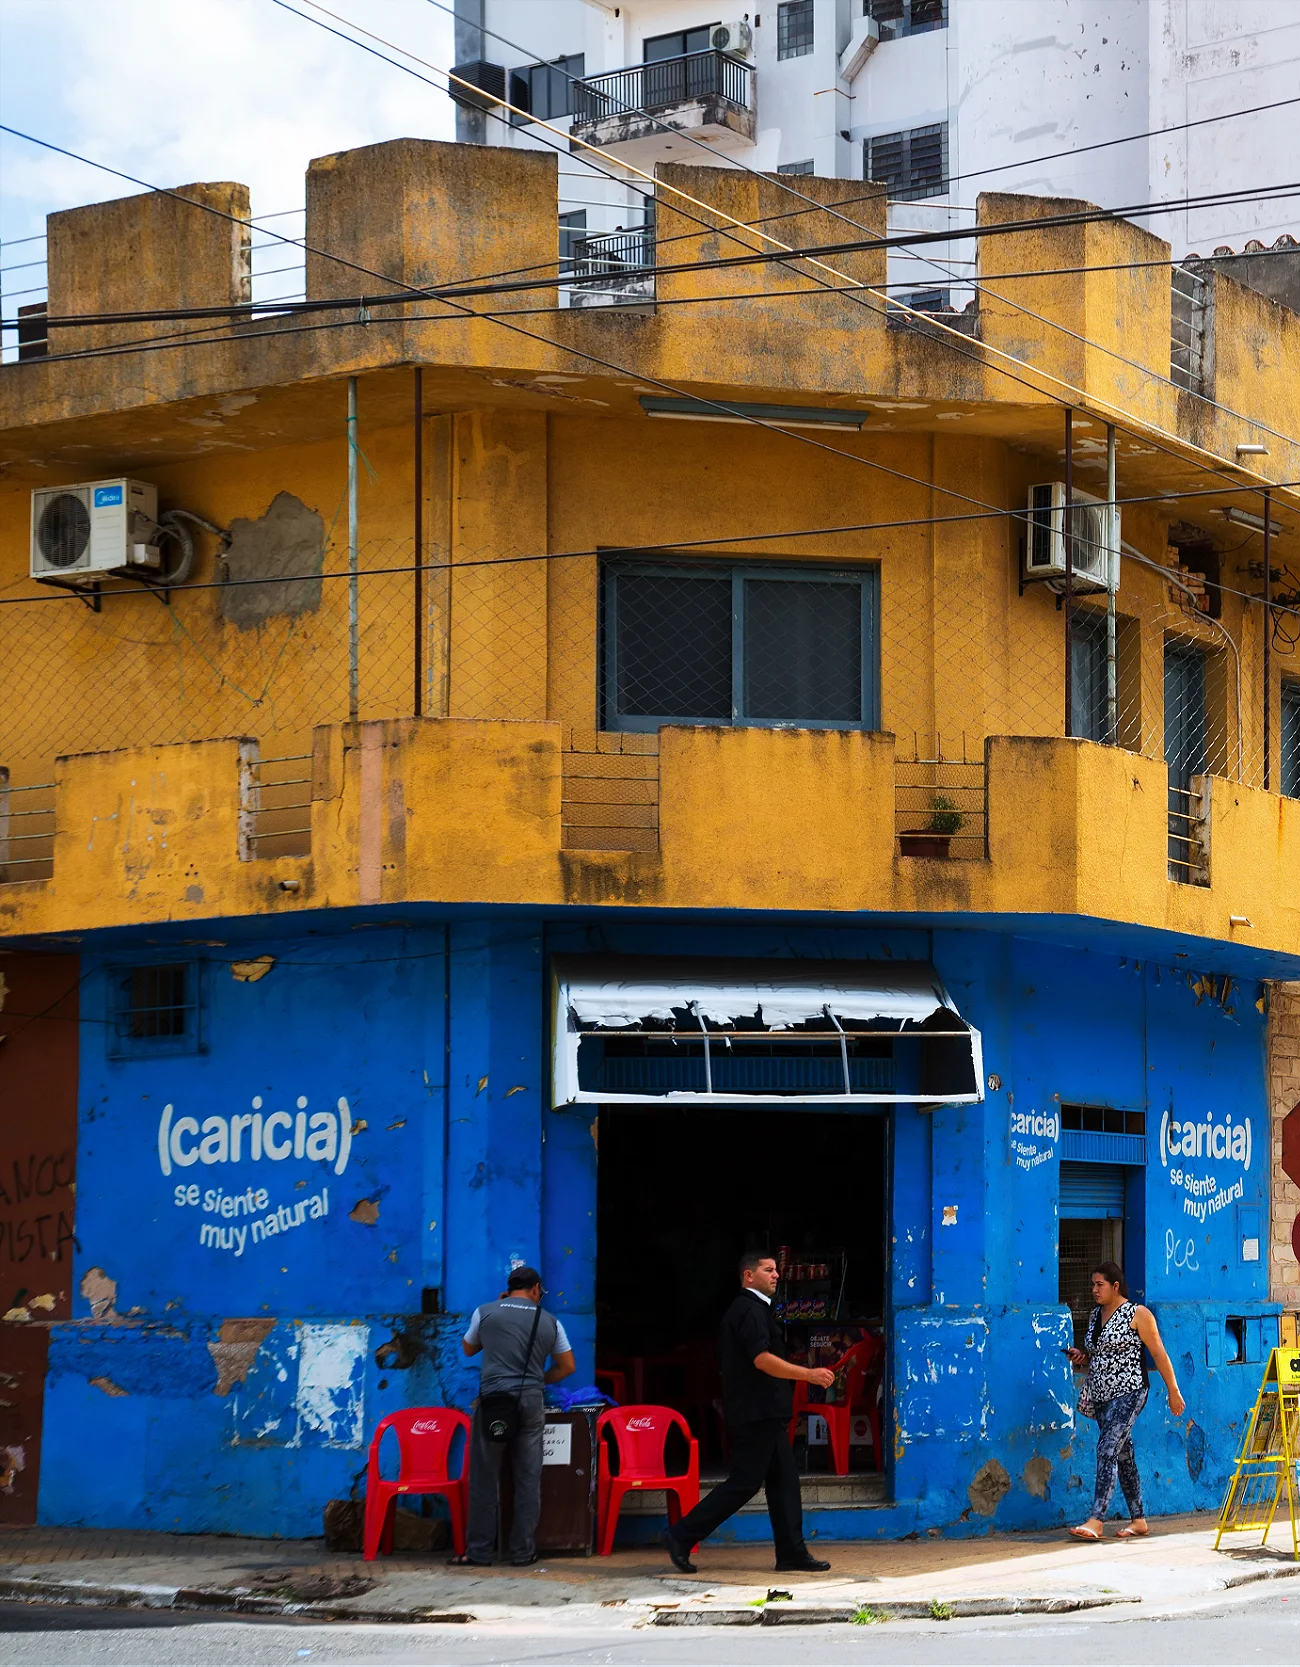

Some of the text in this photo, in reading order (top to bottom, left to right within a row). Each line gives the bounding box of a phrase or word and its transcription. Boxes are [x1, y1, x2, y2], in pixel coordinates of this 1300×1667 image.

[158, 1096, 352, 1176] (caricia)
[1017, 1142, 1037, 1156] siente
[1016, 1146, 1054, 1171] muy natural
[1170, 1168, 1217, 1196] se siente
[174, 1184, 269, 1218] se siente
[1183, 1177, 1244, 1223] muy natural
[200, 1188, 329, 1257] muy natural
